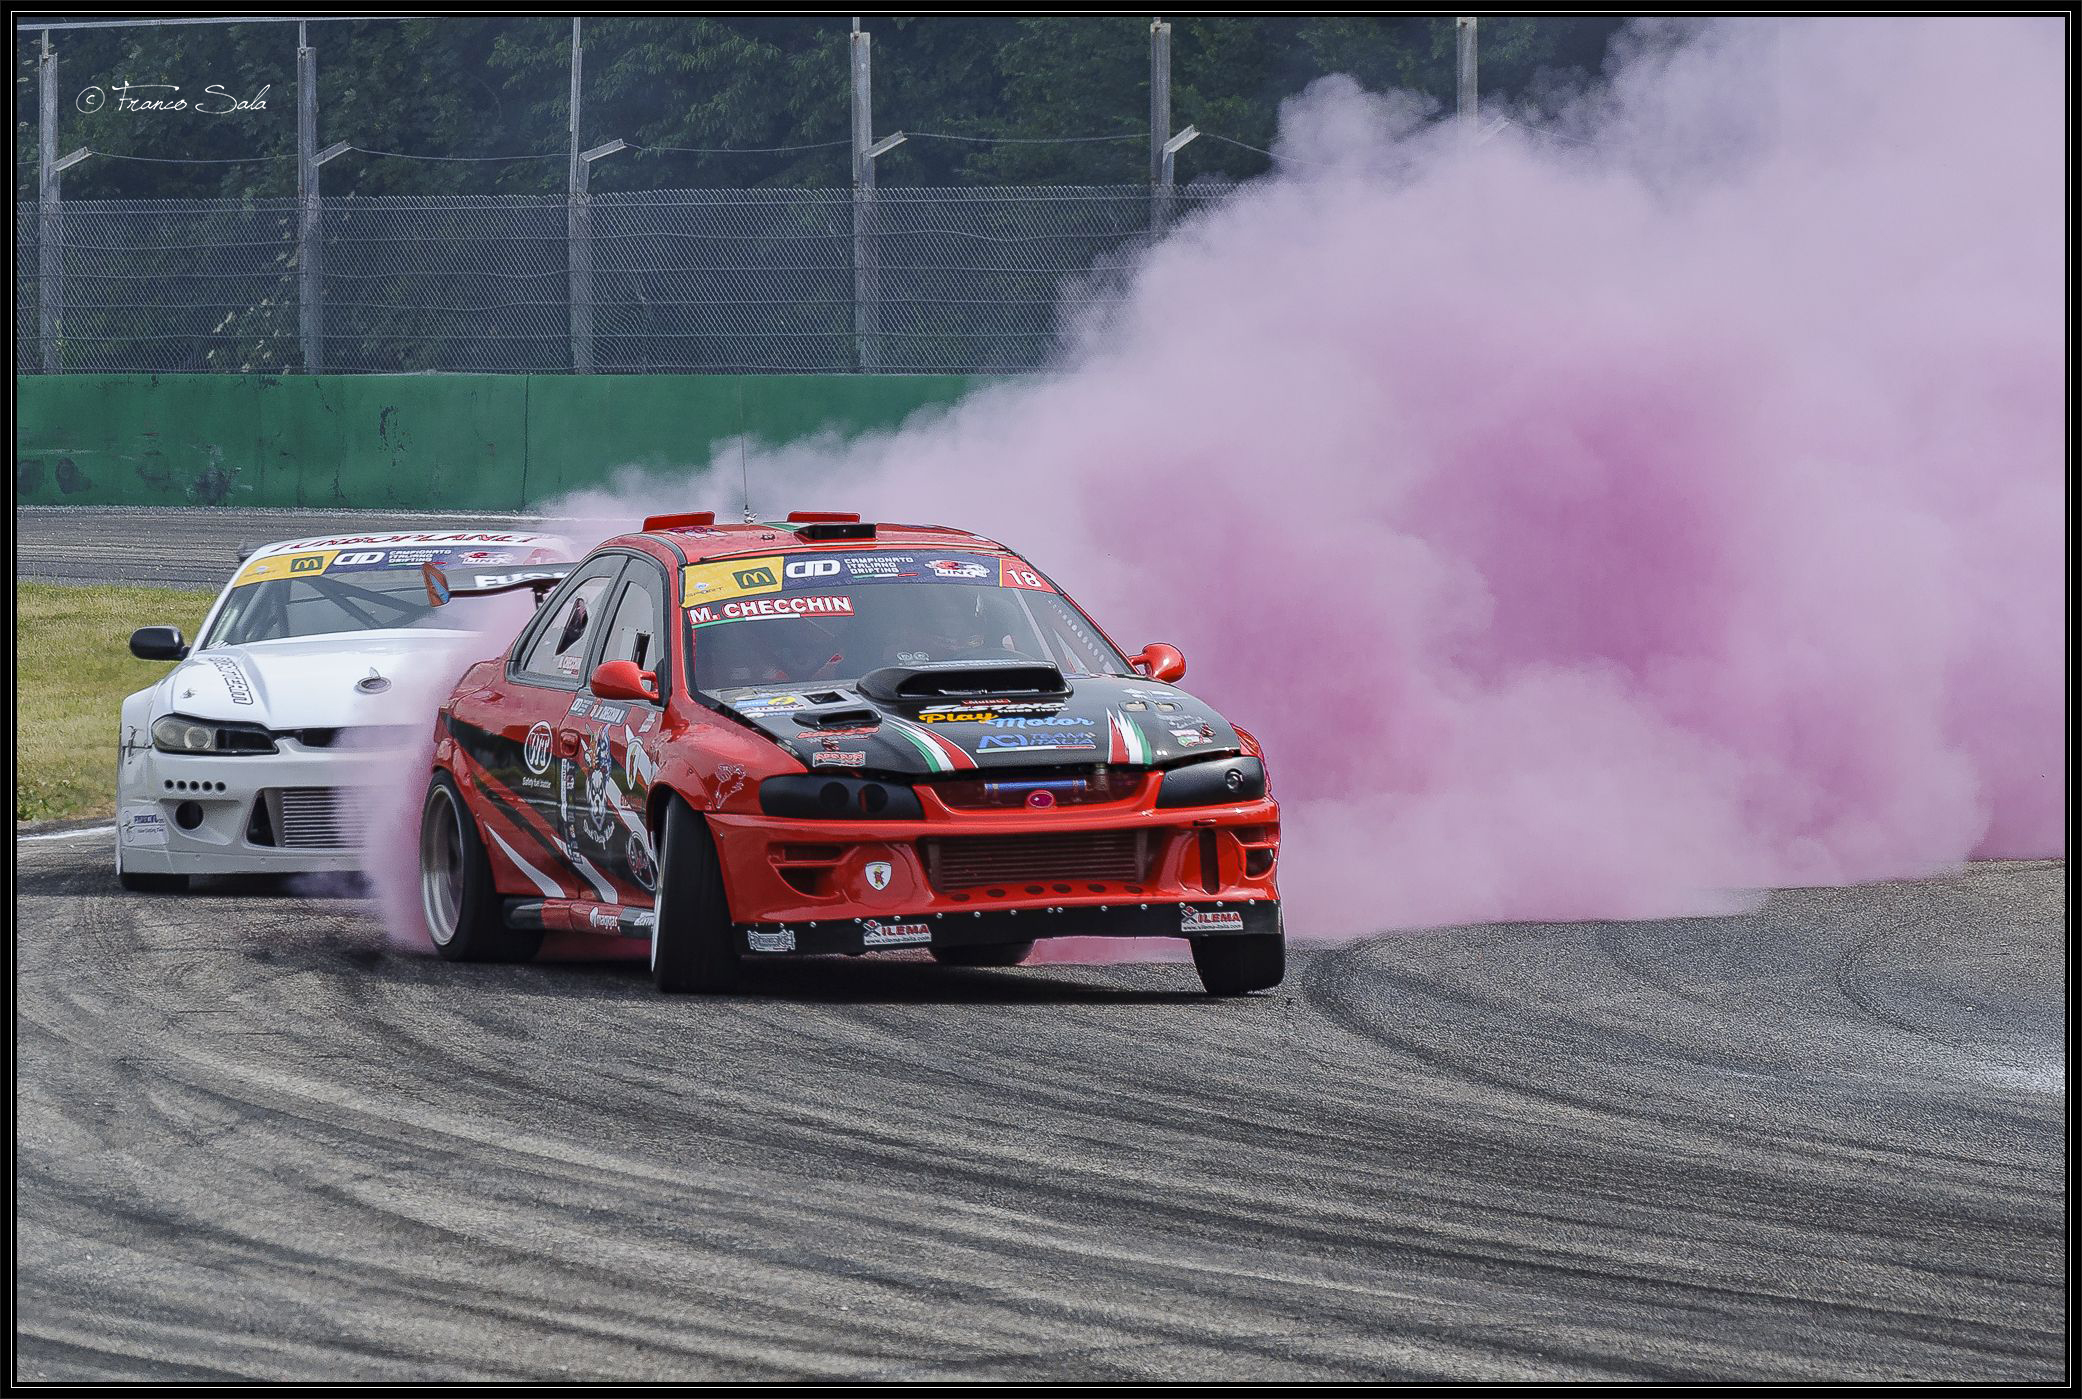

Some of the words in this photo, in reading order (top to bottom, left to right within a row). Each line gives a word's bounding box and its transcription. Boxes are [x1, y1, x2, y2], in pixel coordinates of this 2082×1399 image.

[1006, 568, 1042, 587] 18
[690, 607, 718, 624] M.
[723, 597, 851, 618] CHECCHIN
[919, 712, 1000, 724] Play
[981, 716, 1095, 729] Motor
[1029, 738, 1095, 746] ITALIA
